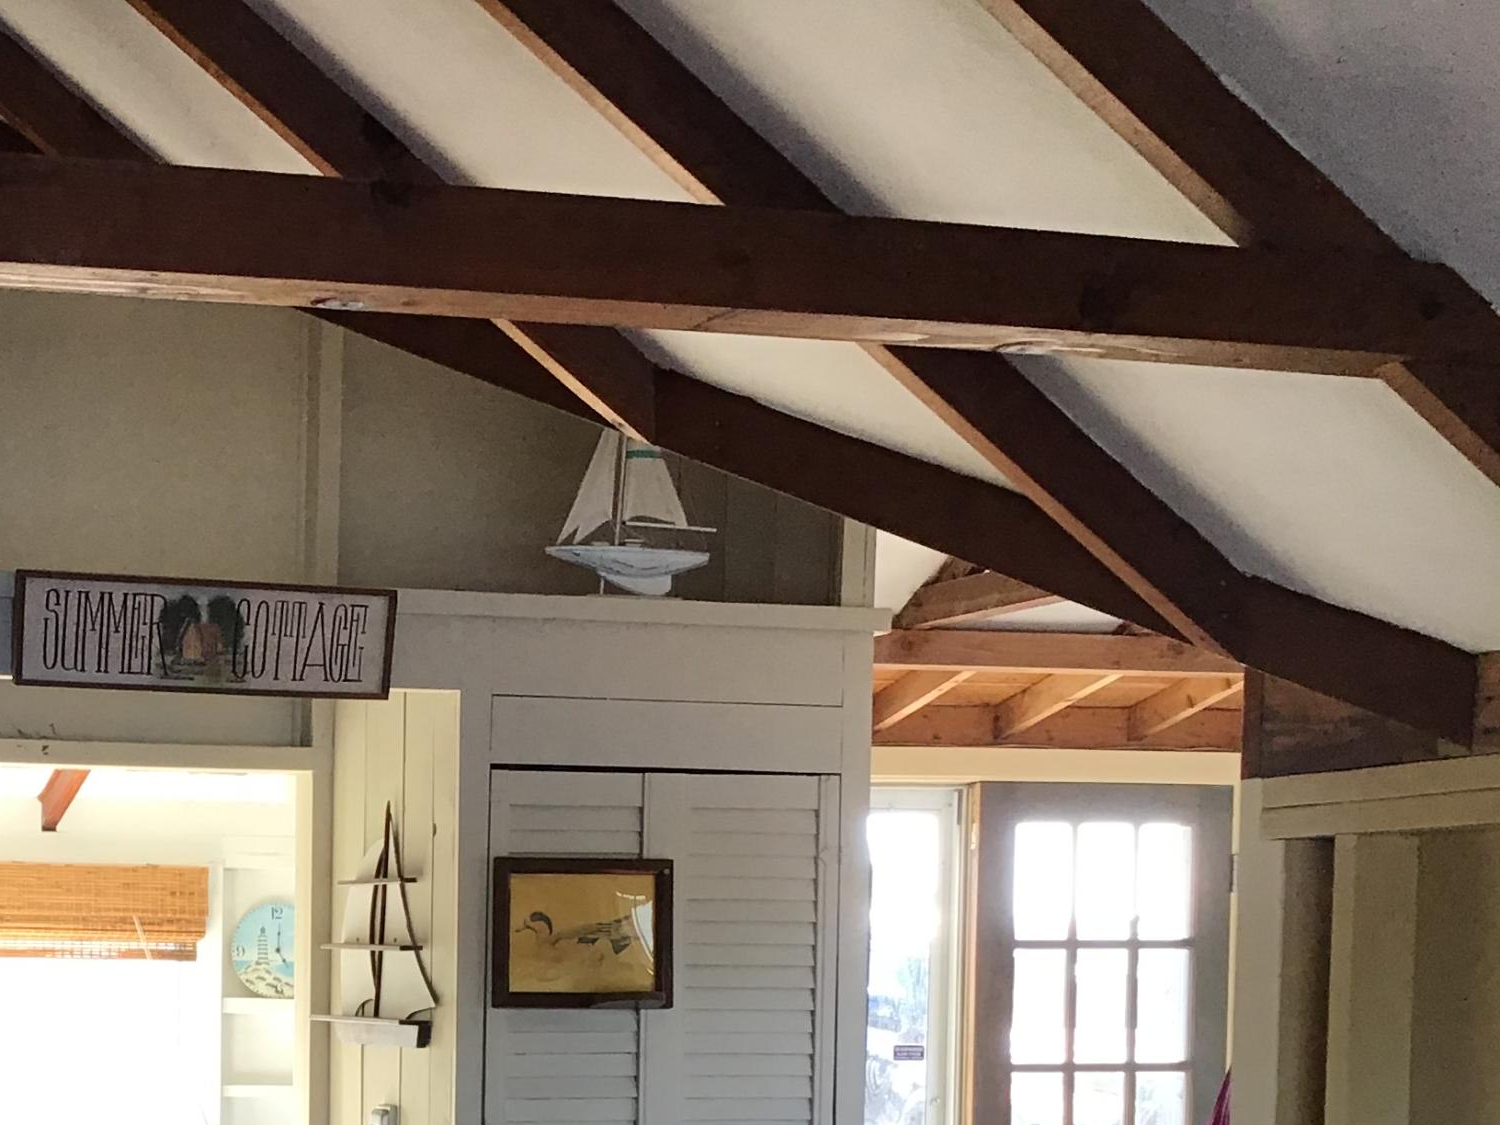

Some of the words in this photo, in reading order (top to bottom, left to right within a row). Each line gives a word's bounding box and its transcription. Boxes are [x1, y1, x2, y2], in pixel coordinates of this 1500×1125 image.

[42, 588, 169, 677] SUMMER
[231, 598, 369, 683] COTTAGE
[271, 907, 283, 920] 12
[236, 944, 246, 957] 9
